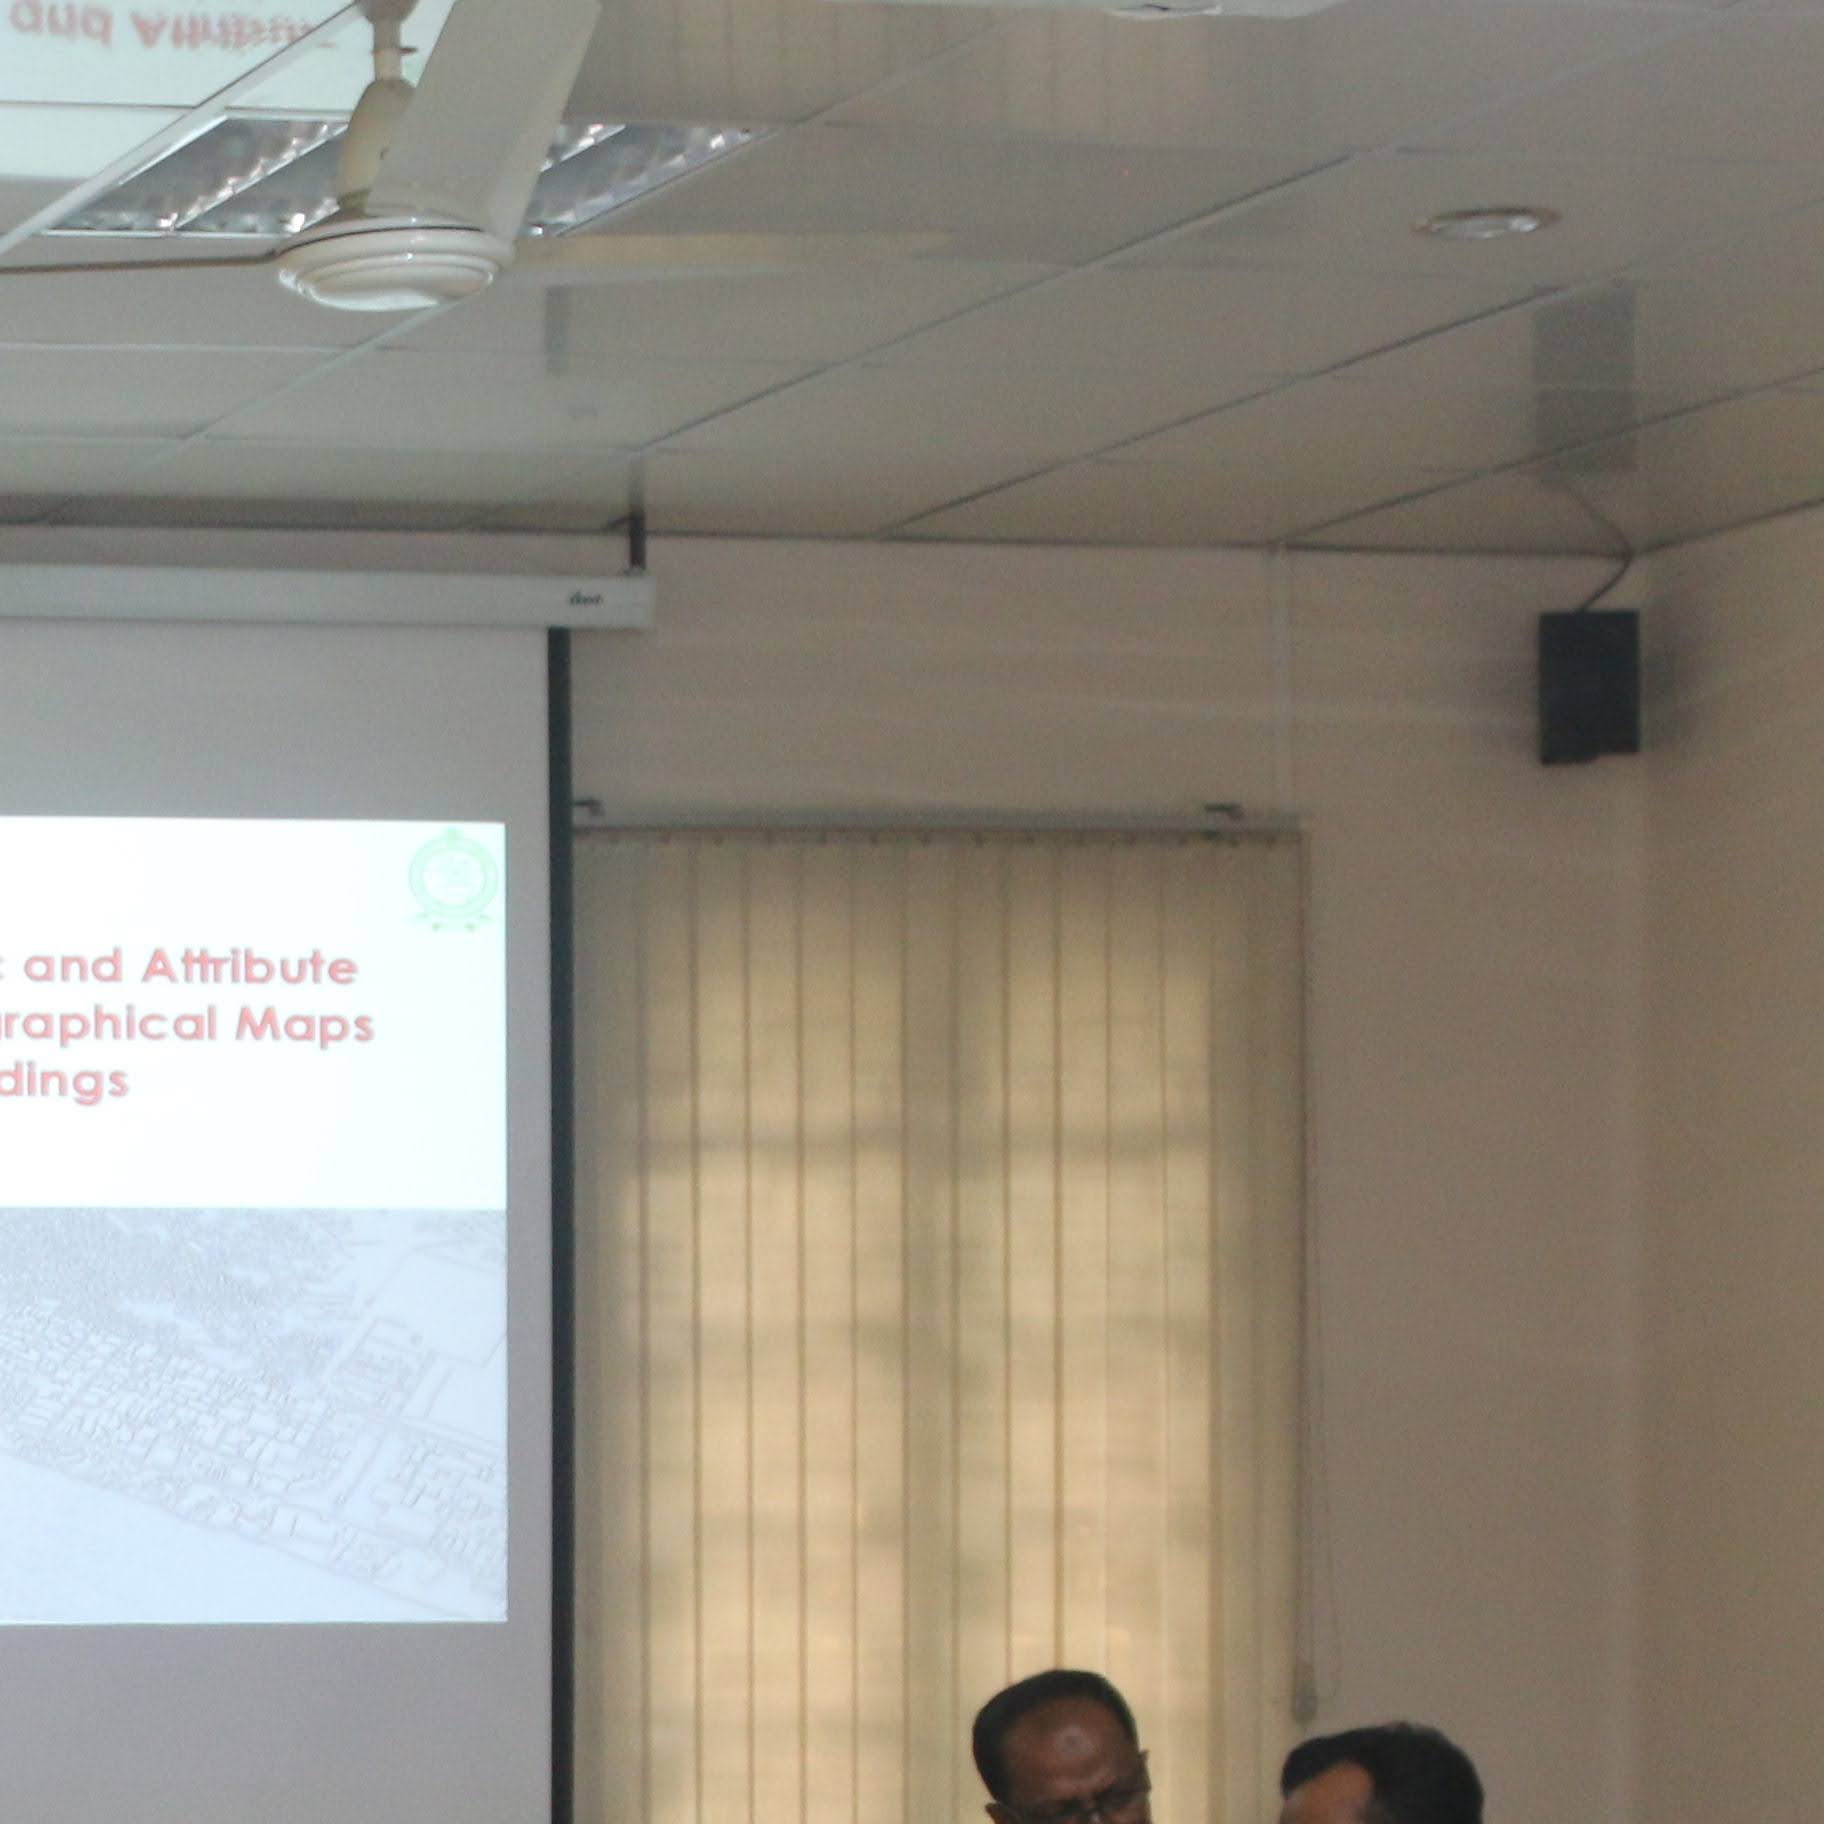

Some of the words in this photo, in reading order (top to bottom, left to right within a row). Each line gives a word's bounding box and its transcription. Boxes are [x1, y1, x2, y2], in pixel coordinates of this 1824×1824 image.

[23, 947, 123, 983] and
[141, 947, 358, 986] Attribute
[235, 1006, 374, 1051] Maps
